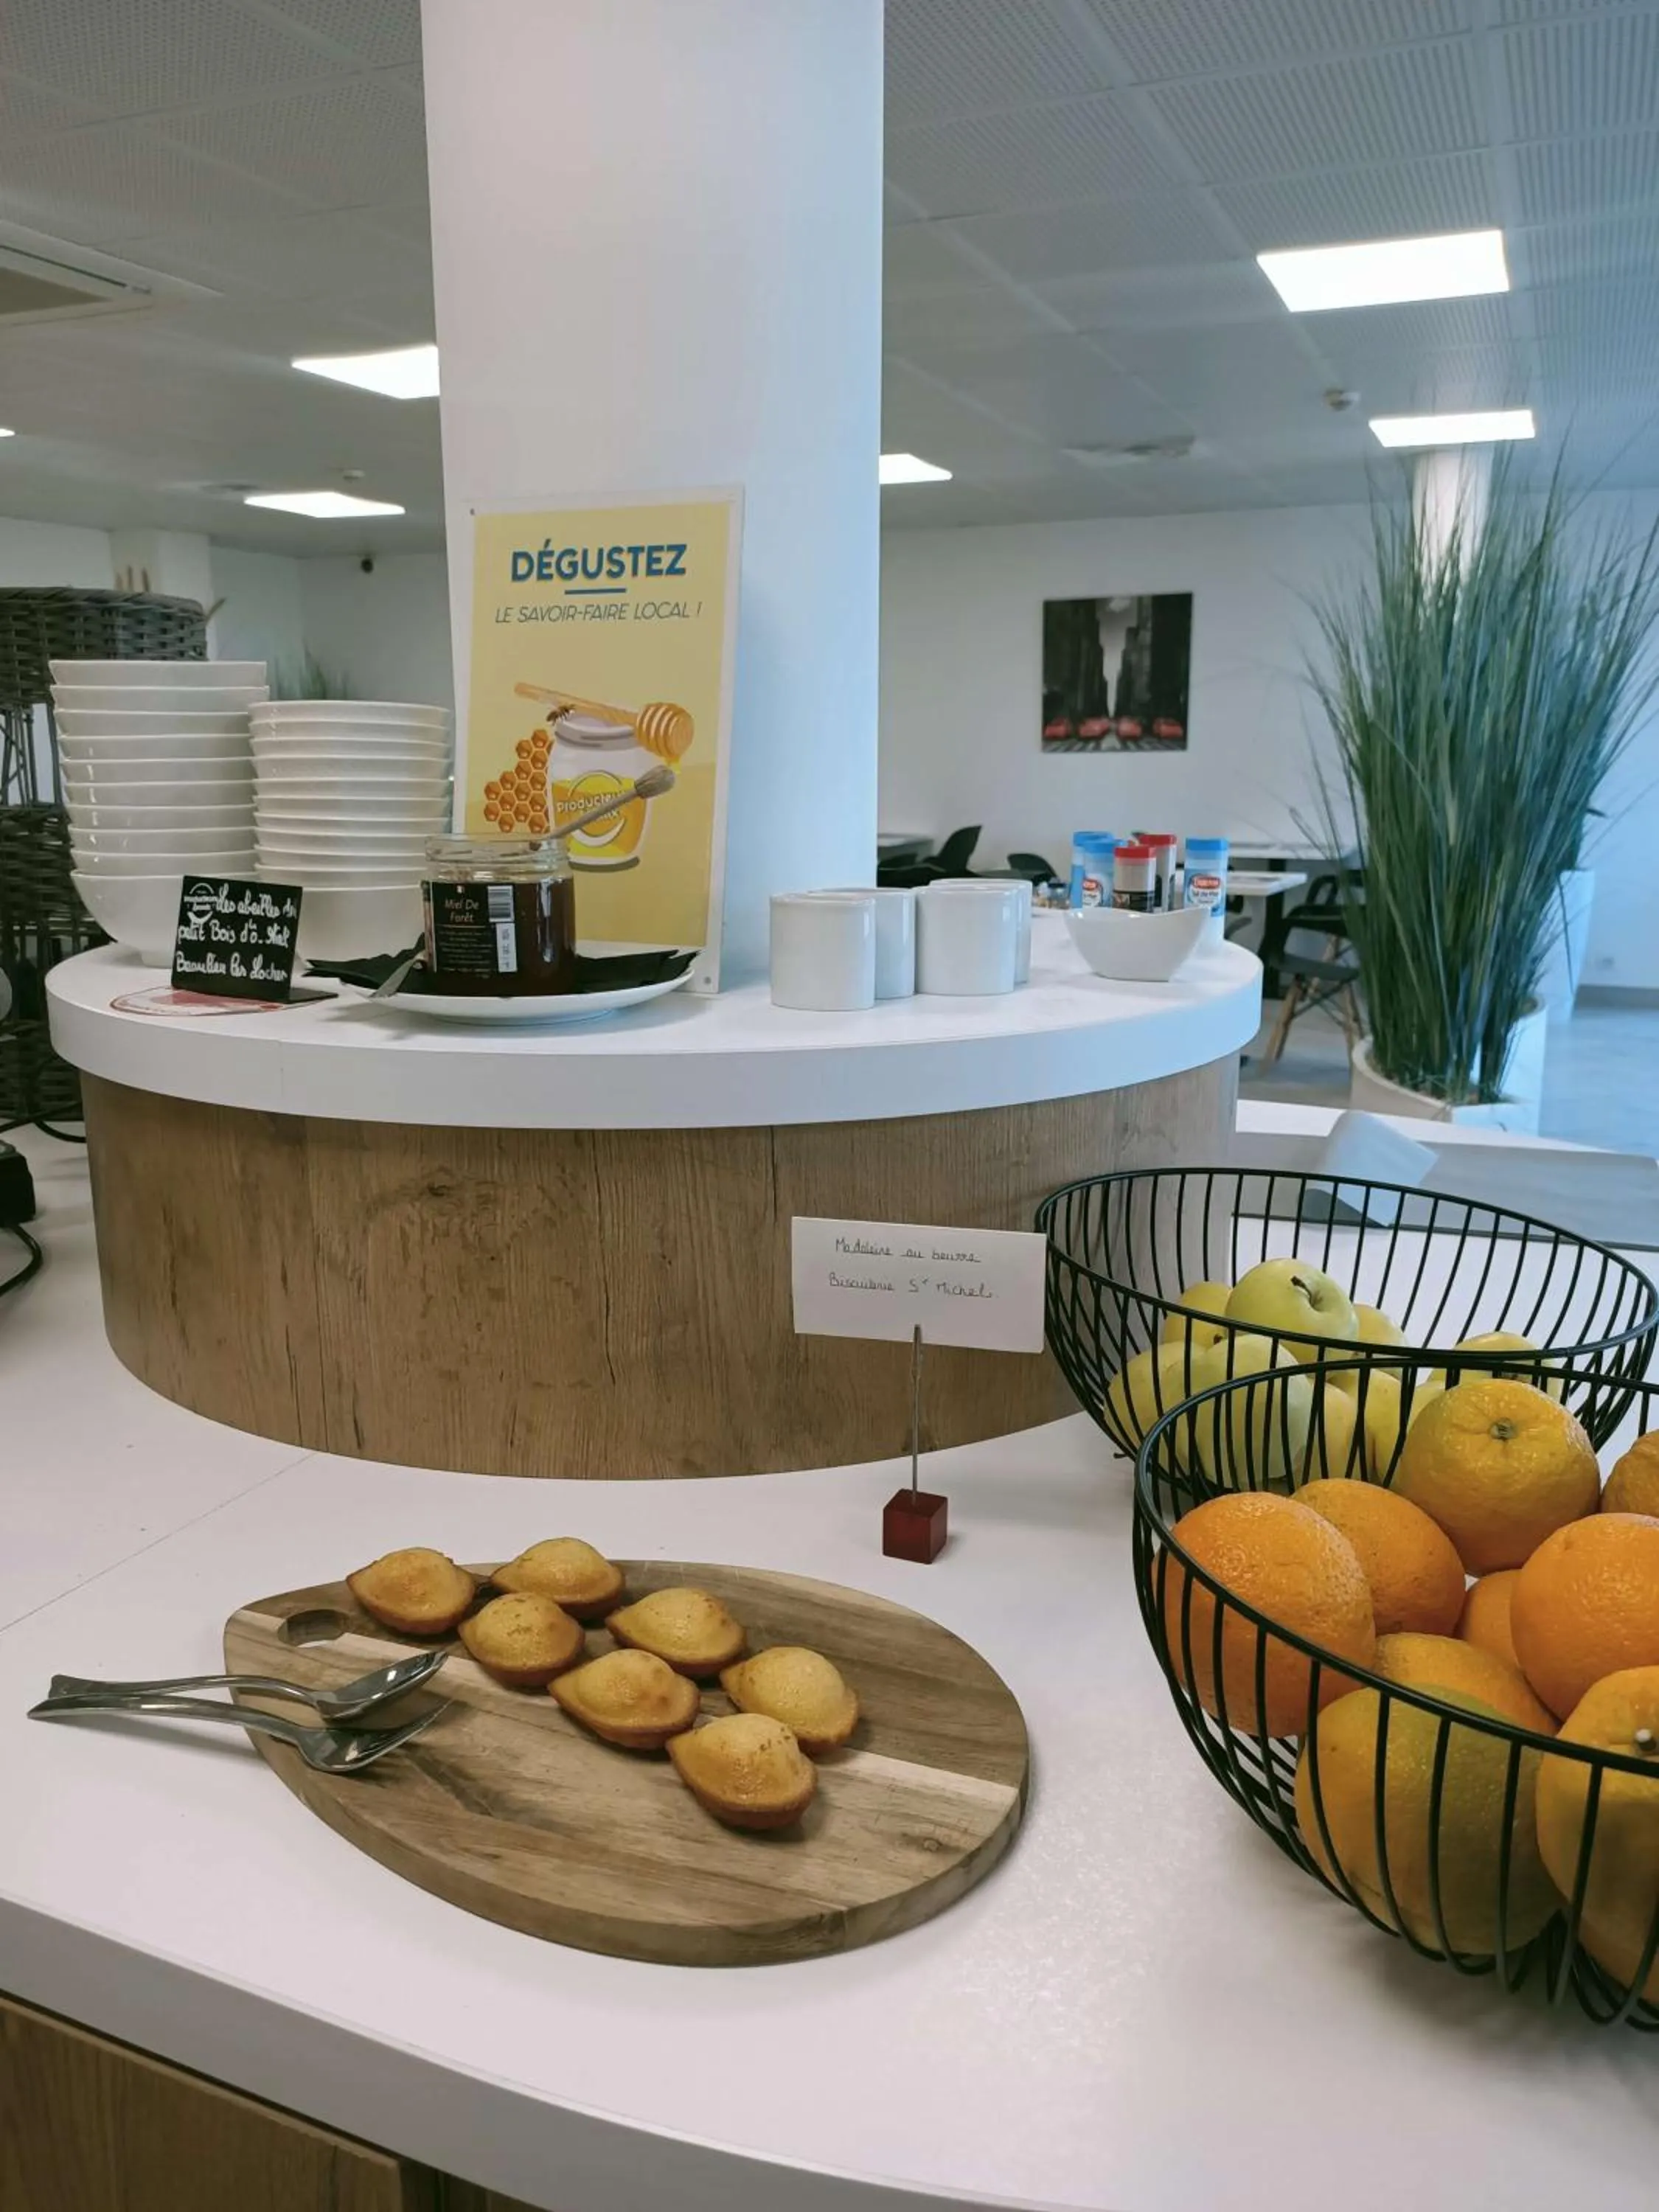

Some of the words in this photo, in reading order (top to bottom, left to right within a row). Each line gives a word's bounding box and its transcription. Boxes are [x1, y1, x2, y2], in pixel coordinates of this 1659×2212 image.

[511, 538, 687, 582] DÉGUSTEZ
[495, 607, 515, 624] LE
[517, 603, 630, 623] SAVOIR-FAIRE
[633, 601, 690, 620] LOCAL
